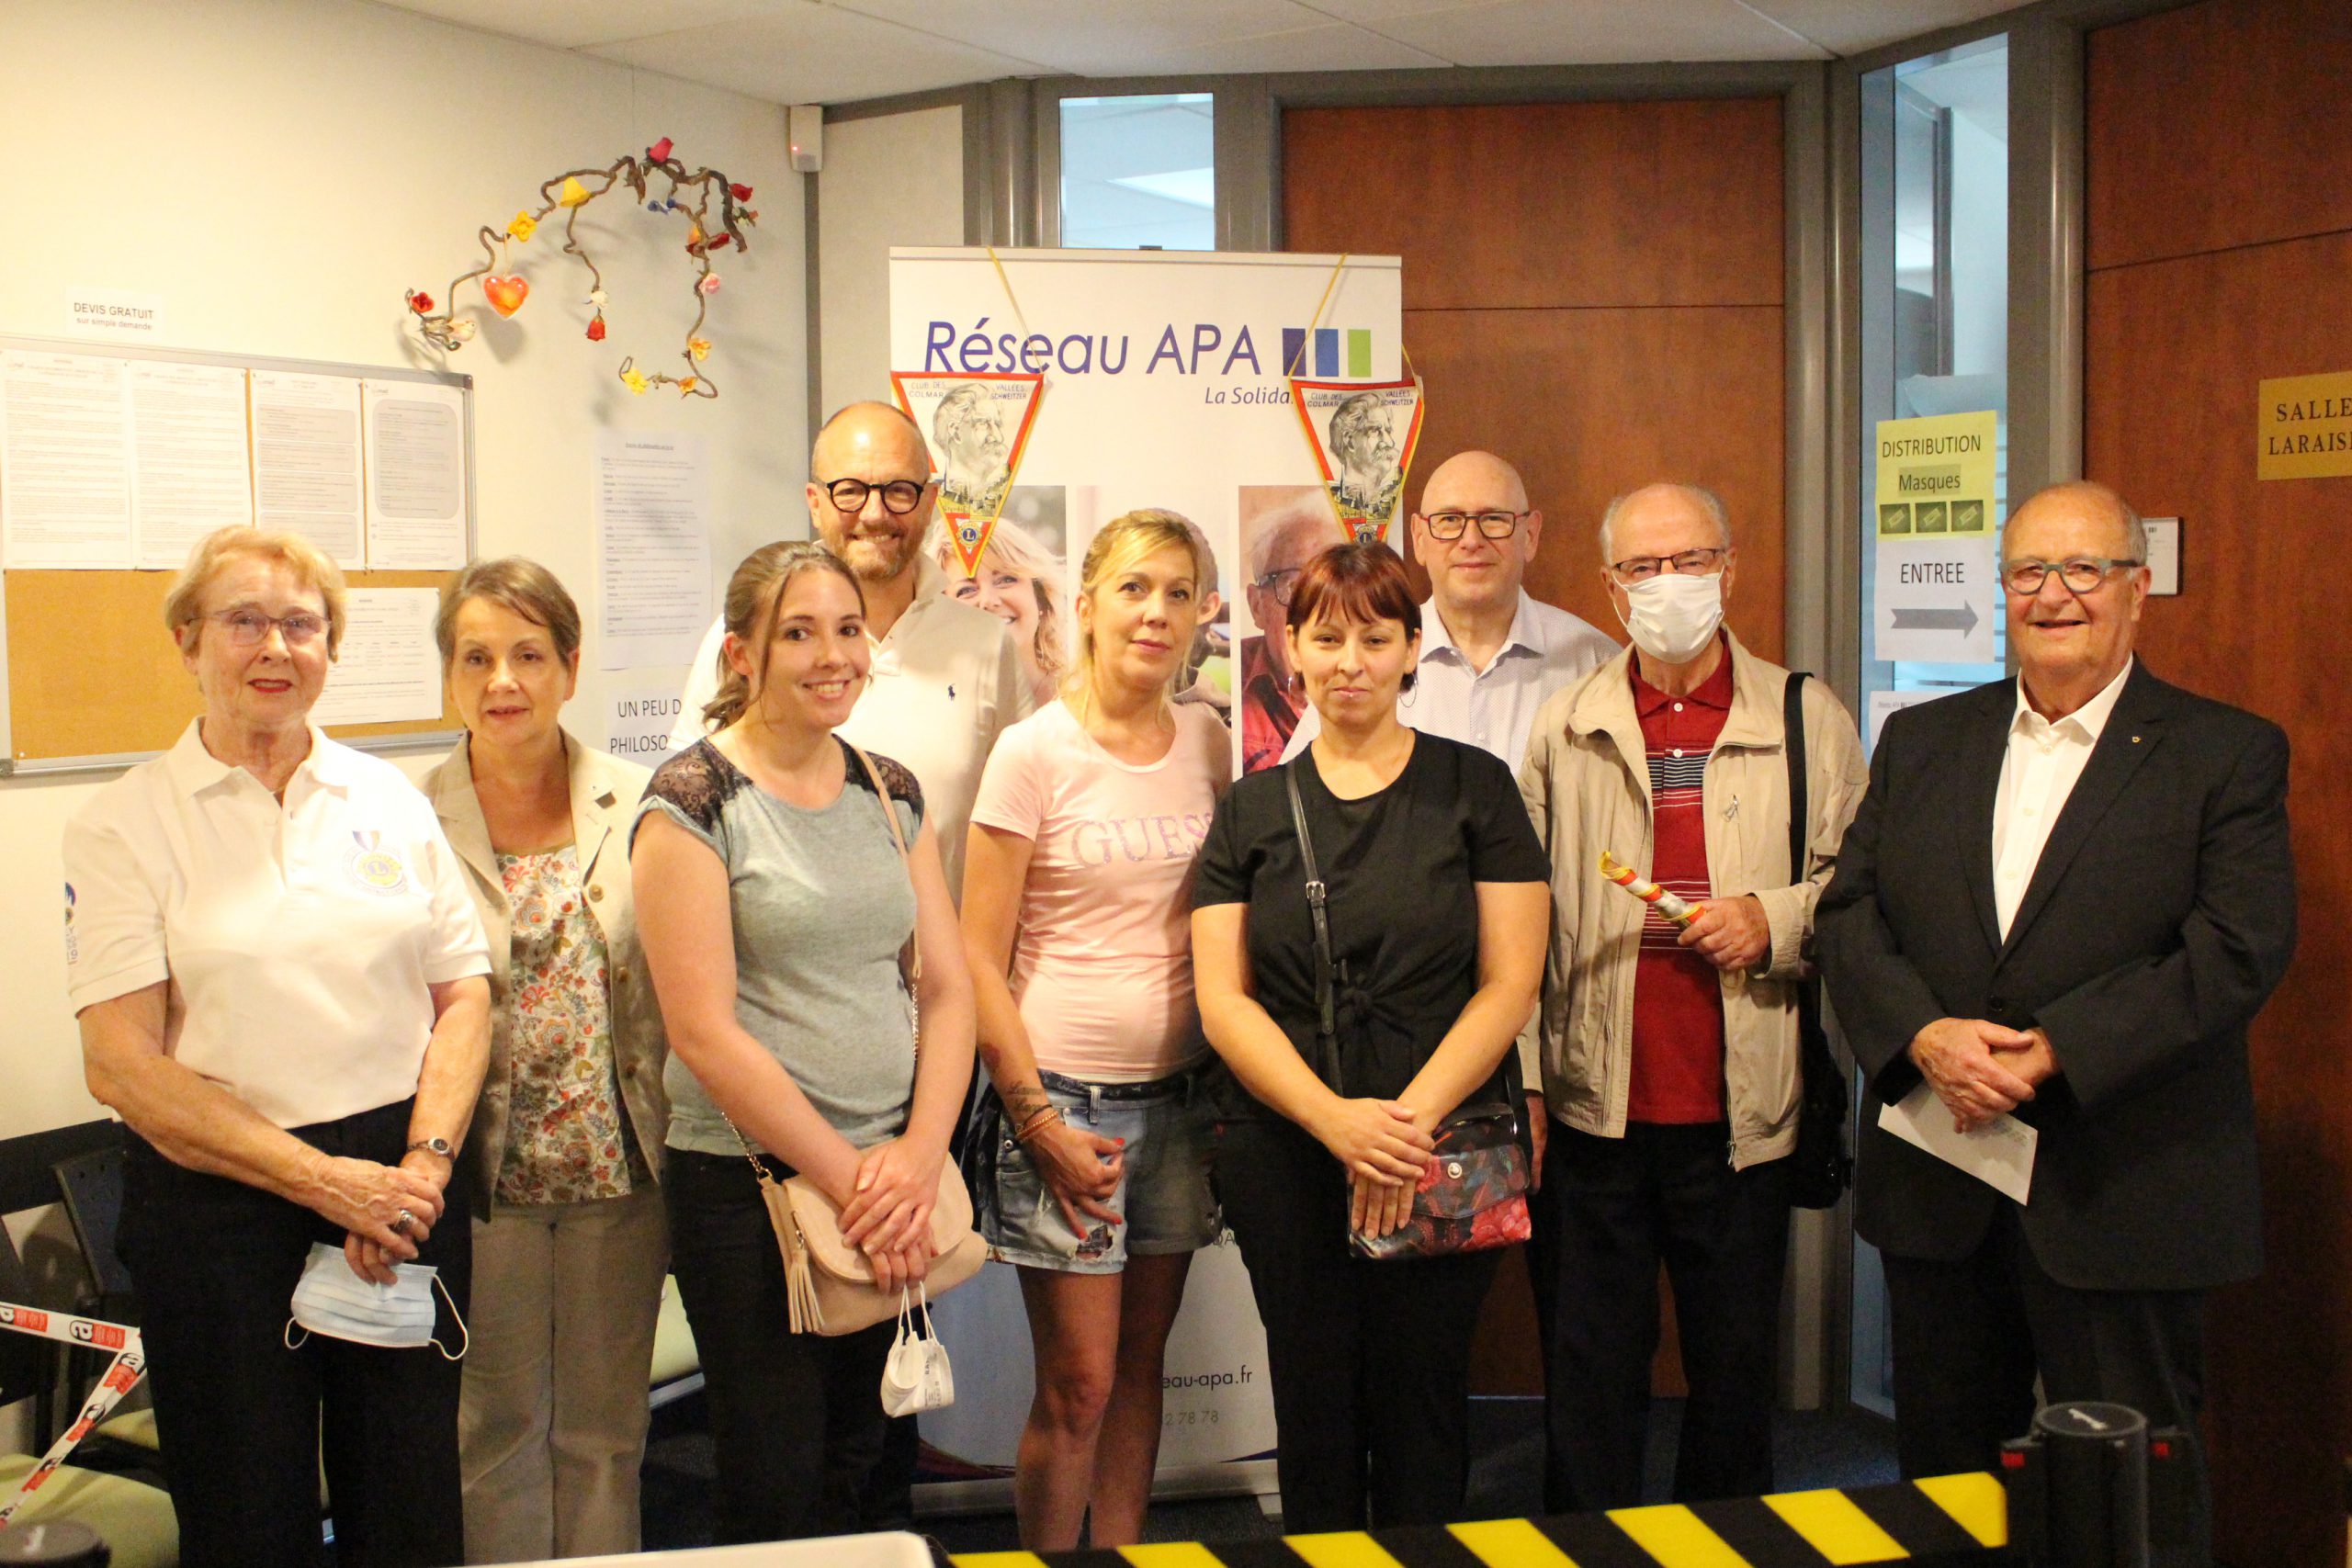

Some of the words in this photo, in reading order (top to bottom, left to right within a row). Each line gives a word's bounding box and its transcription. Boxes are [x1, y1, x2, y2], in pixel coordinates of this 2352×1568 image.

[74, 301, 106, 315] DEVIS
[109, 306, 153, 319] GRATUIT
[924, 317, 1129, 375] Réseau
[1146, 323, 1261, 376] APA
[909, 390, 944, 399] COLMAR
[1204, 387, 1226, 404] La
[1231, 387, 1294, 404] Solida
[2276, 397, 2352, 423] SALLE
[1882, 434, 1982, 458] DISTRIBUTION
[2268, 431, 2352, 456] LARAIS
[1898, 473, 1962, 493] Masques
[1900, 562, 1965, 584] ENTREE
[617, 701, 639, 717] UN
[642, 699, 668, 716] PEU
[673, 698, 682, 715] D
[610, 734, 668, 754] PHILOSO
[1071, 812, 1214, 868] GUES
[1162, 1364, 1252, 1392] eau-apa.fr
[1165, 1413, 1173, 1426] 2
[1179, 1412, 1195, 1425] 78
[1201, 1411, 1219, 1424] 78
